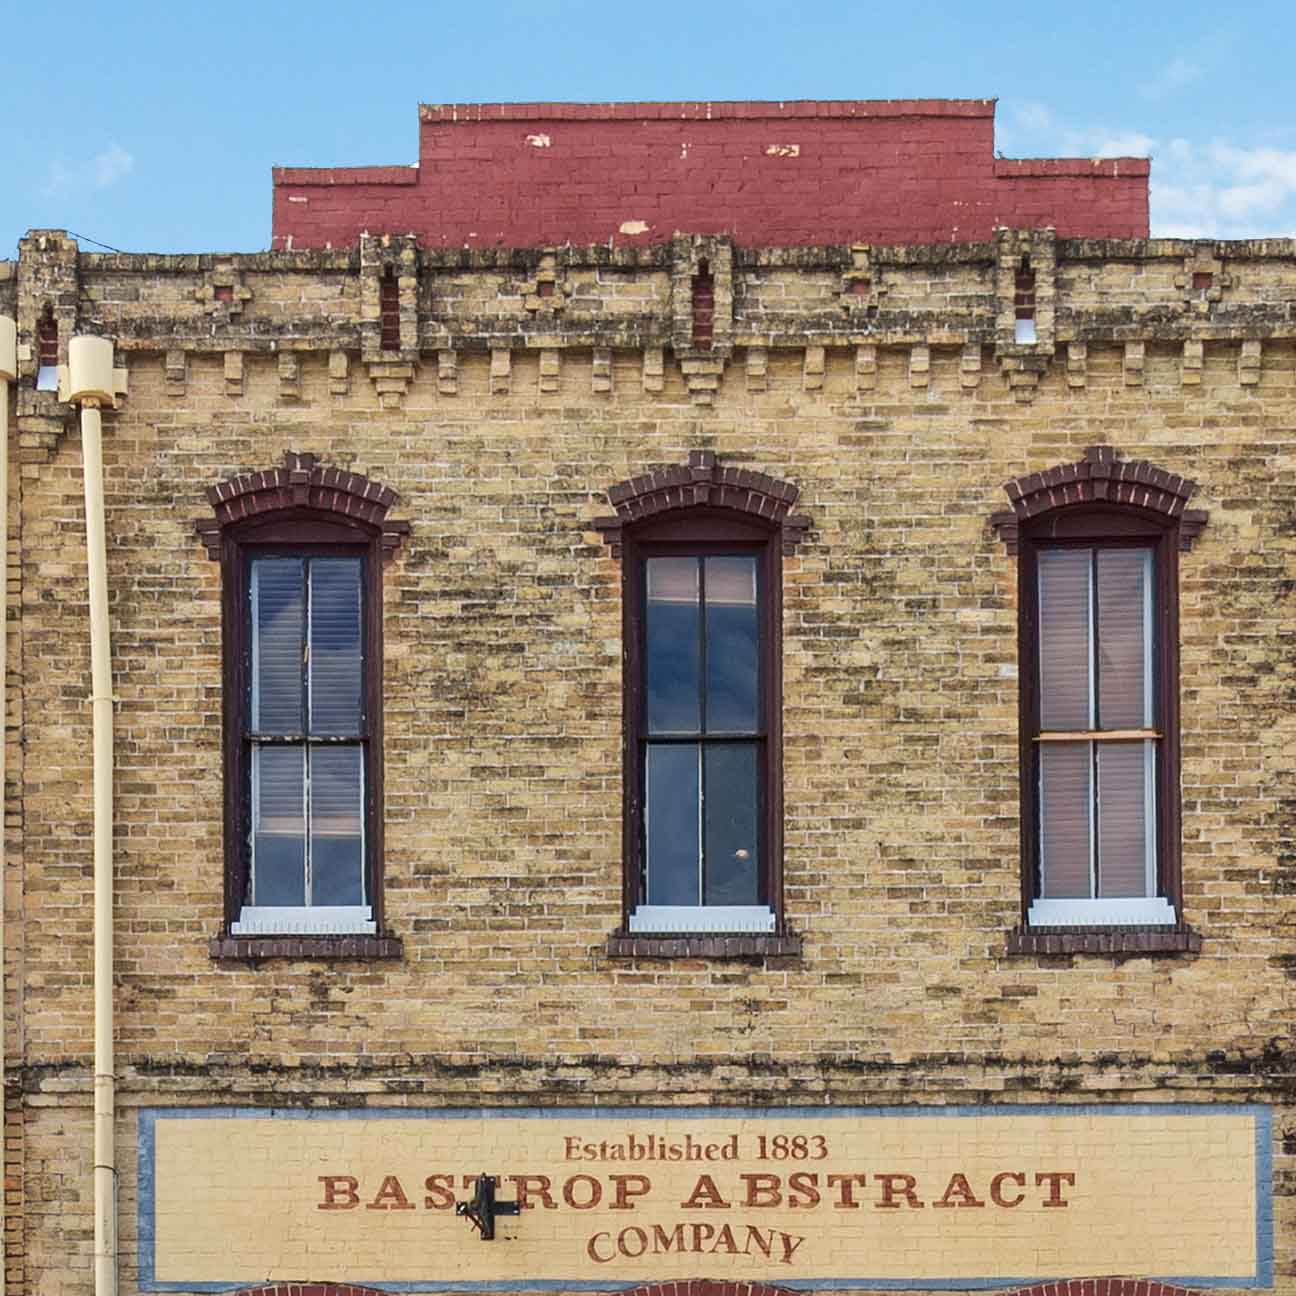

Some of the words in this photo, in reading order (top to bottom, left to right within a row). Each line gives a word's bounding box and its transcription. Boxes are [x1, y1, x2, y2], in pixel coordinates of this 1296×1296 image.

[563, 1134, 739, 1162] Established
[756, 1134, 829, 1161] 1883
[680, 1171, 1076, 1210] ABSTRACT
[587, 1222, 806, 1265] COMPANY
